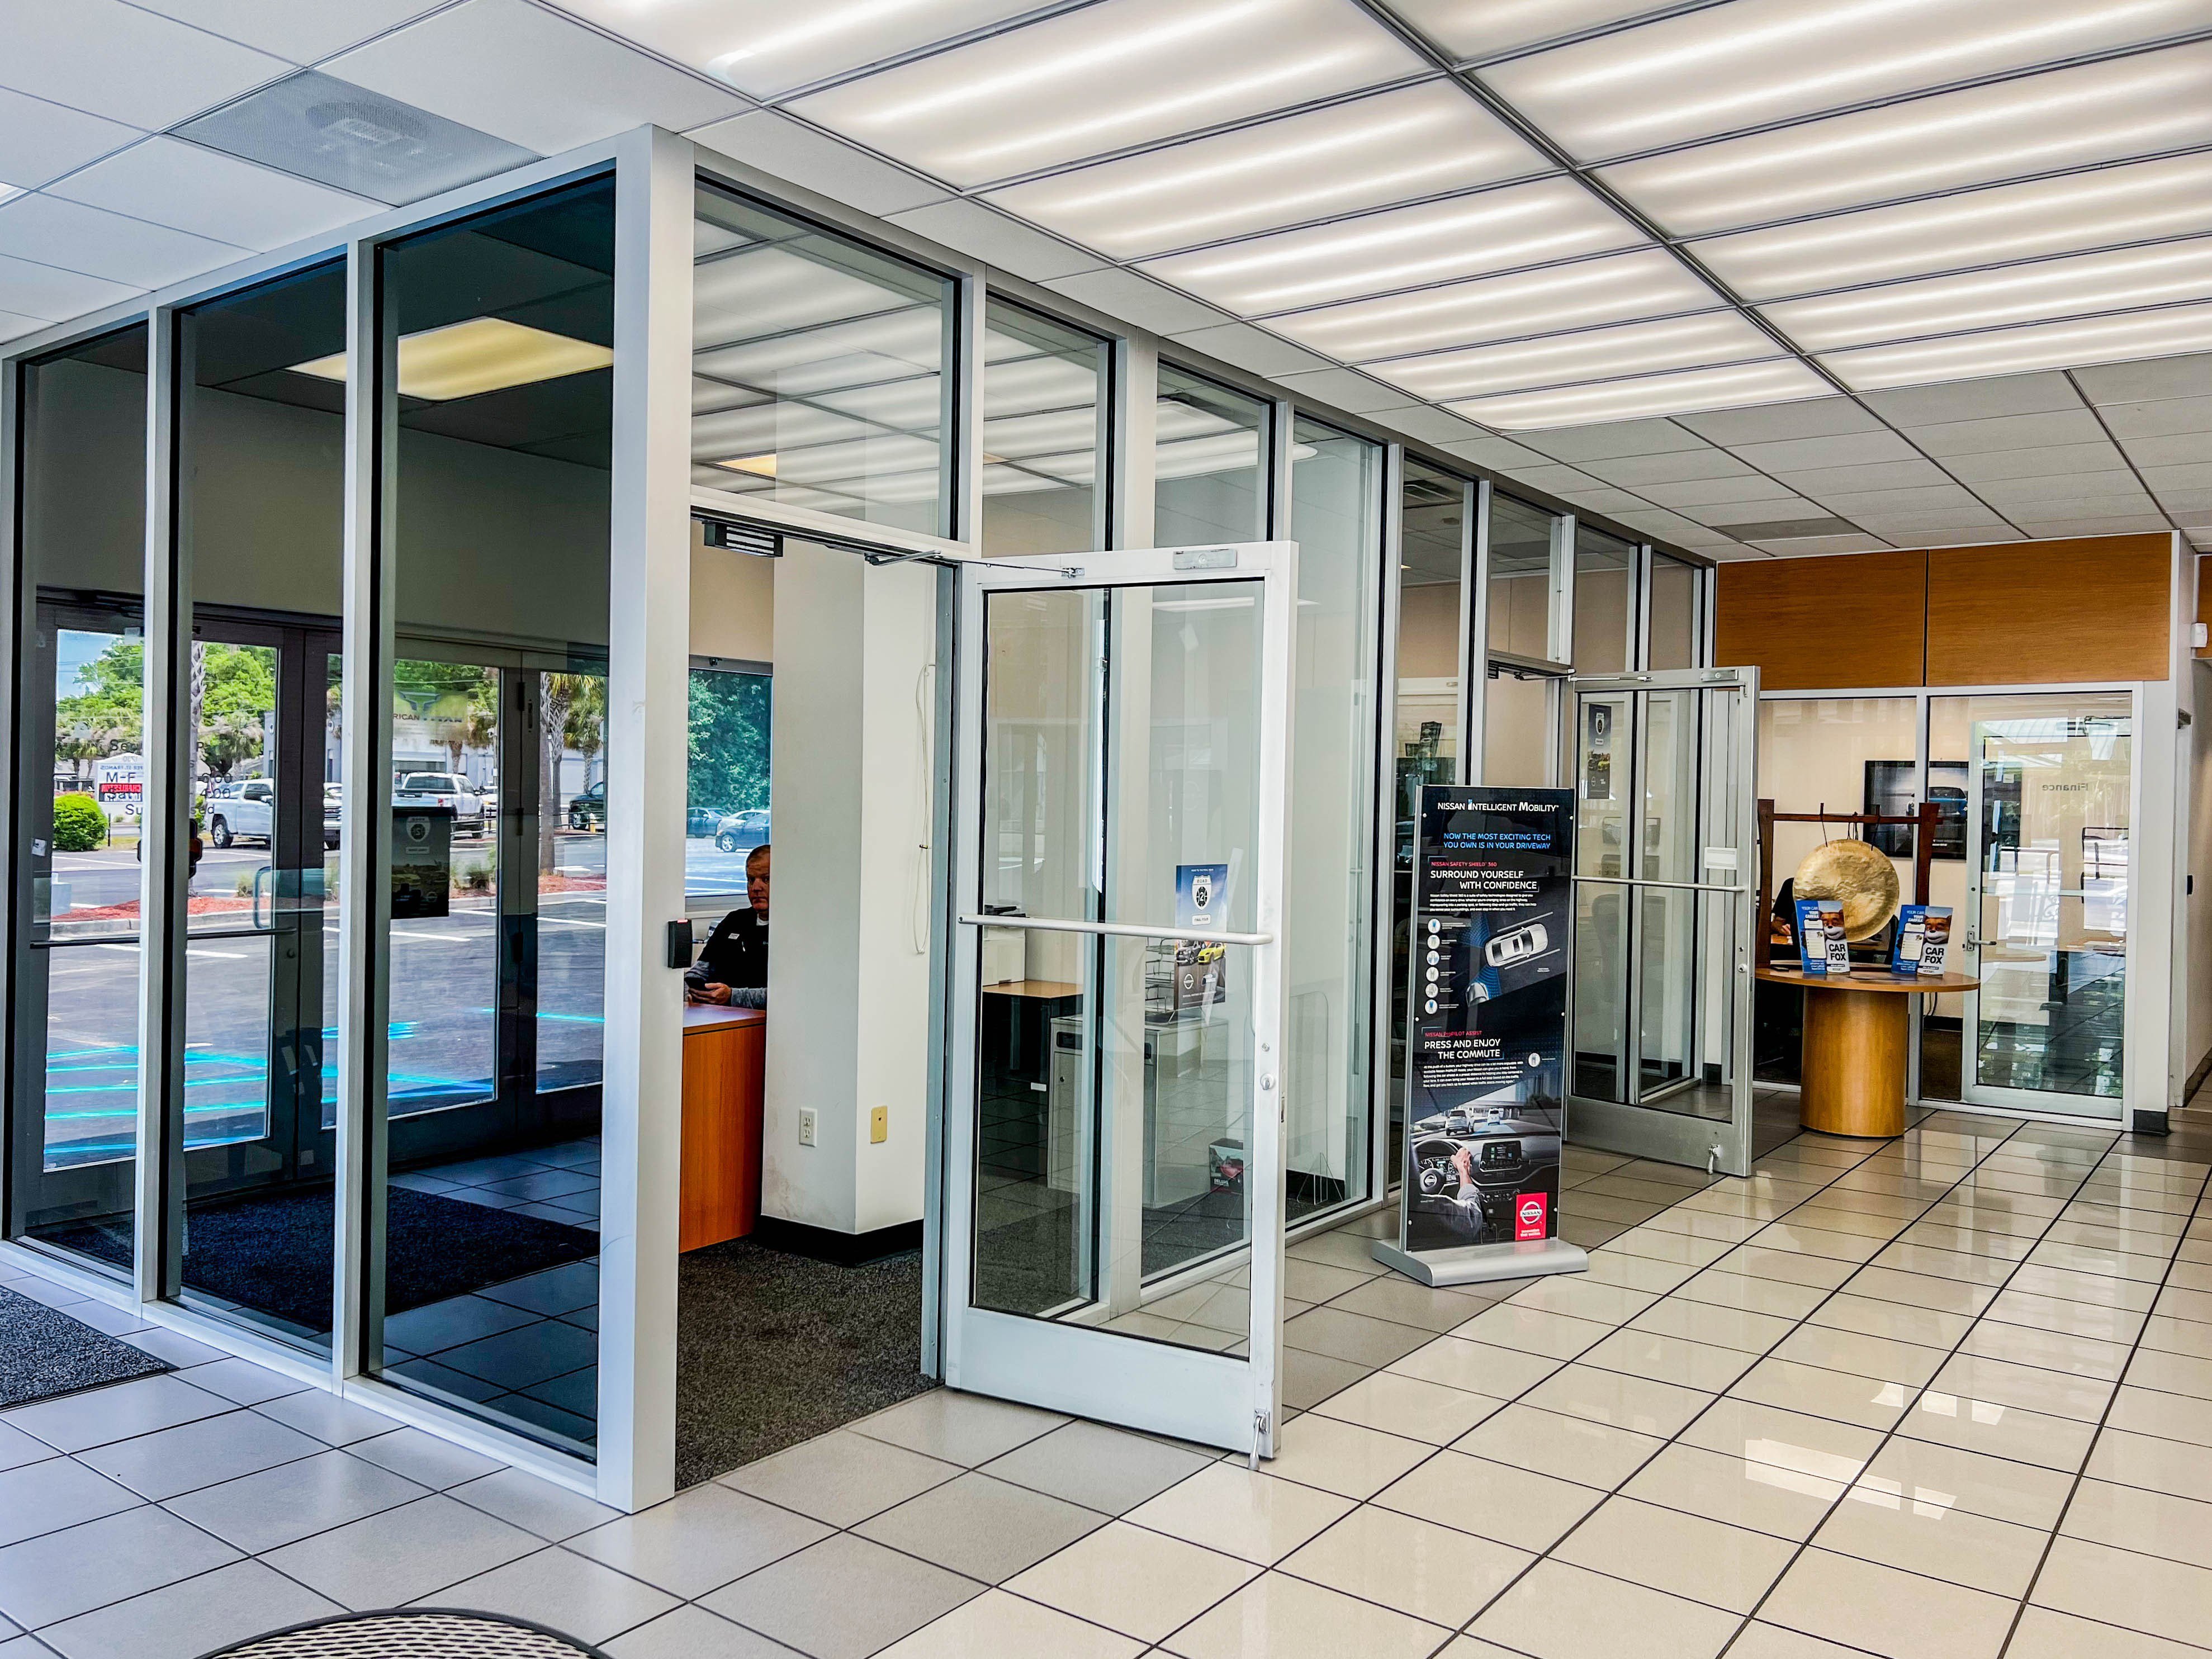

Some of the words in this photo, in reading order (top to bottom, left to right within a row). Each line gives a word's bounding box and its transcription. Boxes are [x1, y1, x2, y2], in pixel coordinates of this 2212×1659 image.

[1430, 870, 1479, 879] SURROUND
[1480, 870, 1524, 879] YOURSELF
[1459, 881, 1481, 889] WITH
[1829, 944, 1846, 952] CAR
[1925, 947, 1944, 956] CAR
[1830, 952, 1846, 961] FOX
[1924, 956, 1943, 964] FOX
[1424, 1040, 1451, 1049] PRESS
[1453, 1040, 1472, 1048] AND
[1474, 1039, 1501, 1047] ENJOY
[1457, 1049, 1500, 1059] COMMUTE
